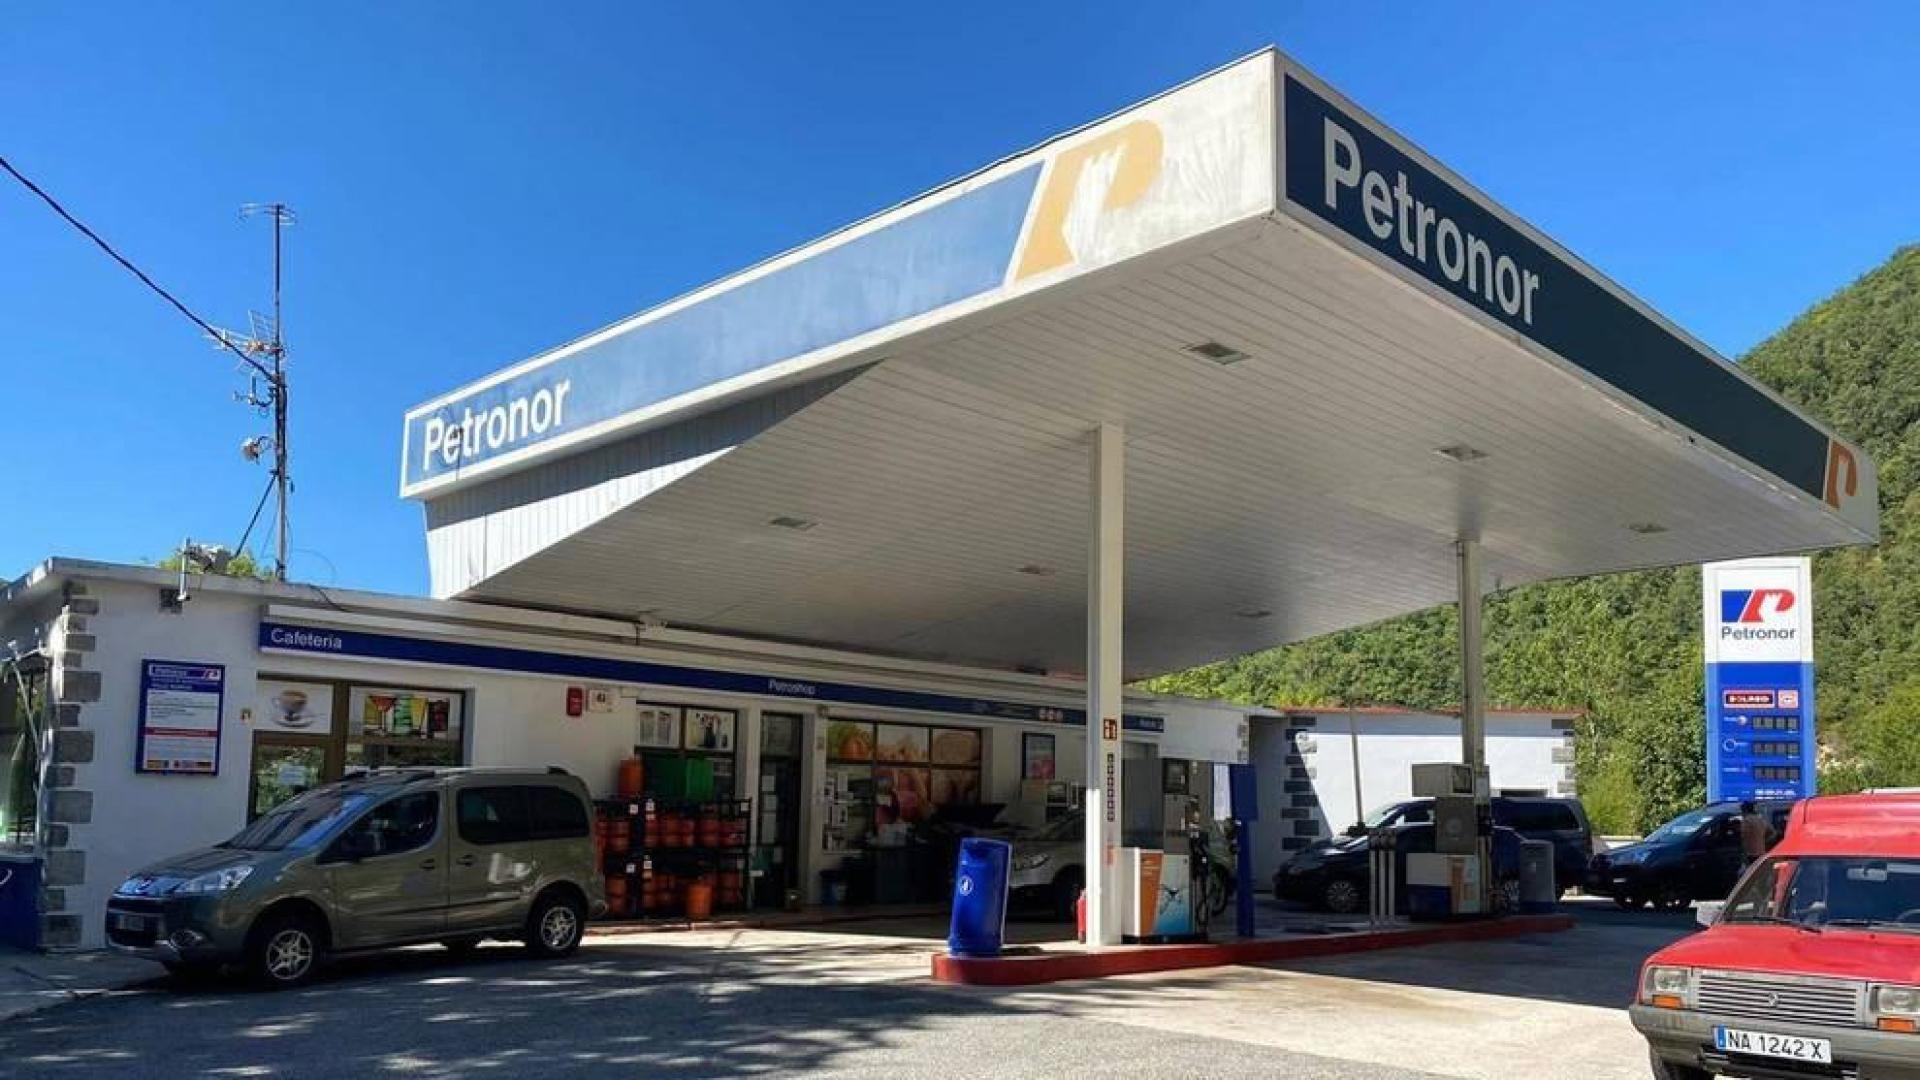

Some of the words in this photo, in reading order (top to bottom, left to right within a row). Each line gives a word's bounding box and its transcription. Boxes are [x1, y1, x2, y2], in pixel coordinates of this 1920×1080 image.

[1324, 116, 1539, 325] Petronor
[424, 379, 571, 471] Petronor
[1721, 626, 1796, 640] Petronor
[1728, 1030, 1751, 1050] NA
[1758, 1034, 1805, 1057] 1242
[1810, 1040, 1823, 1060] X
